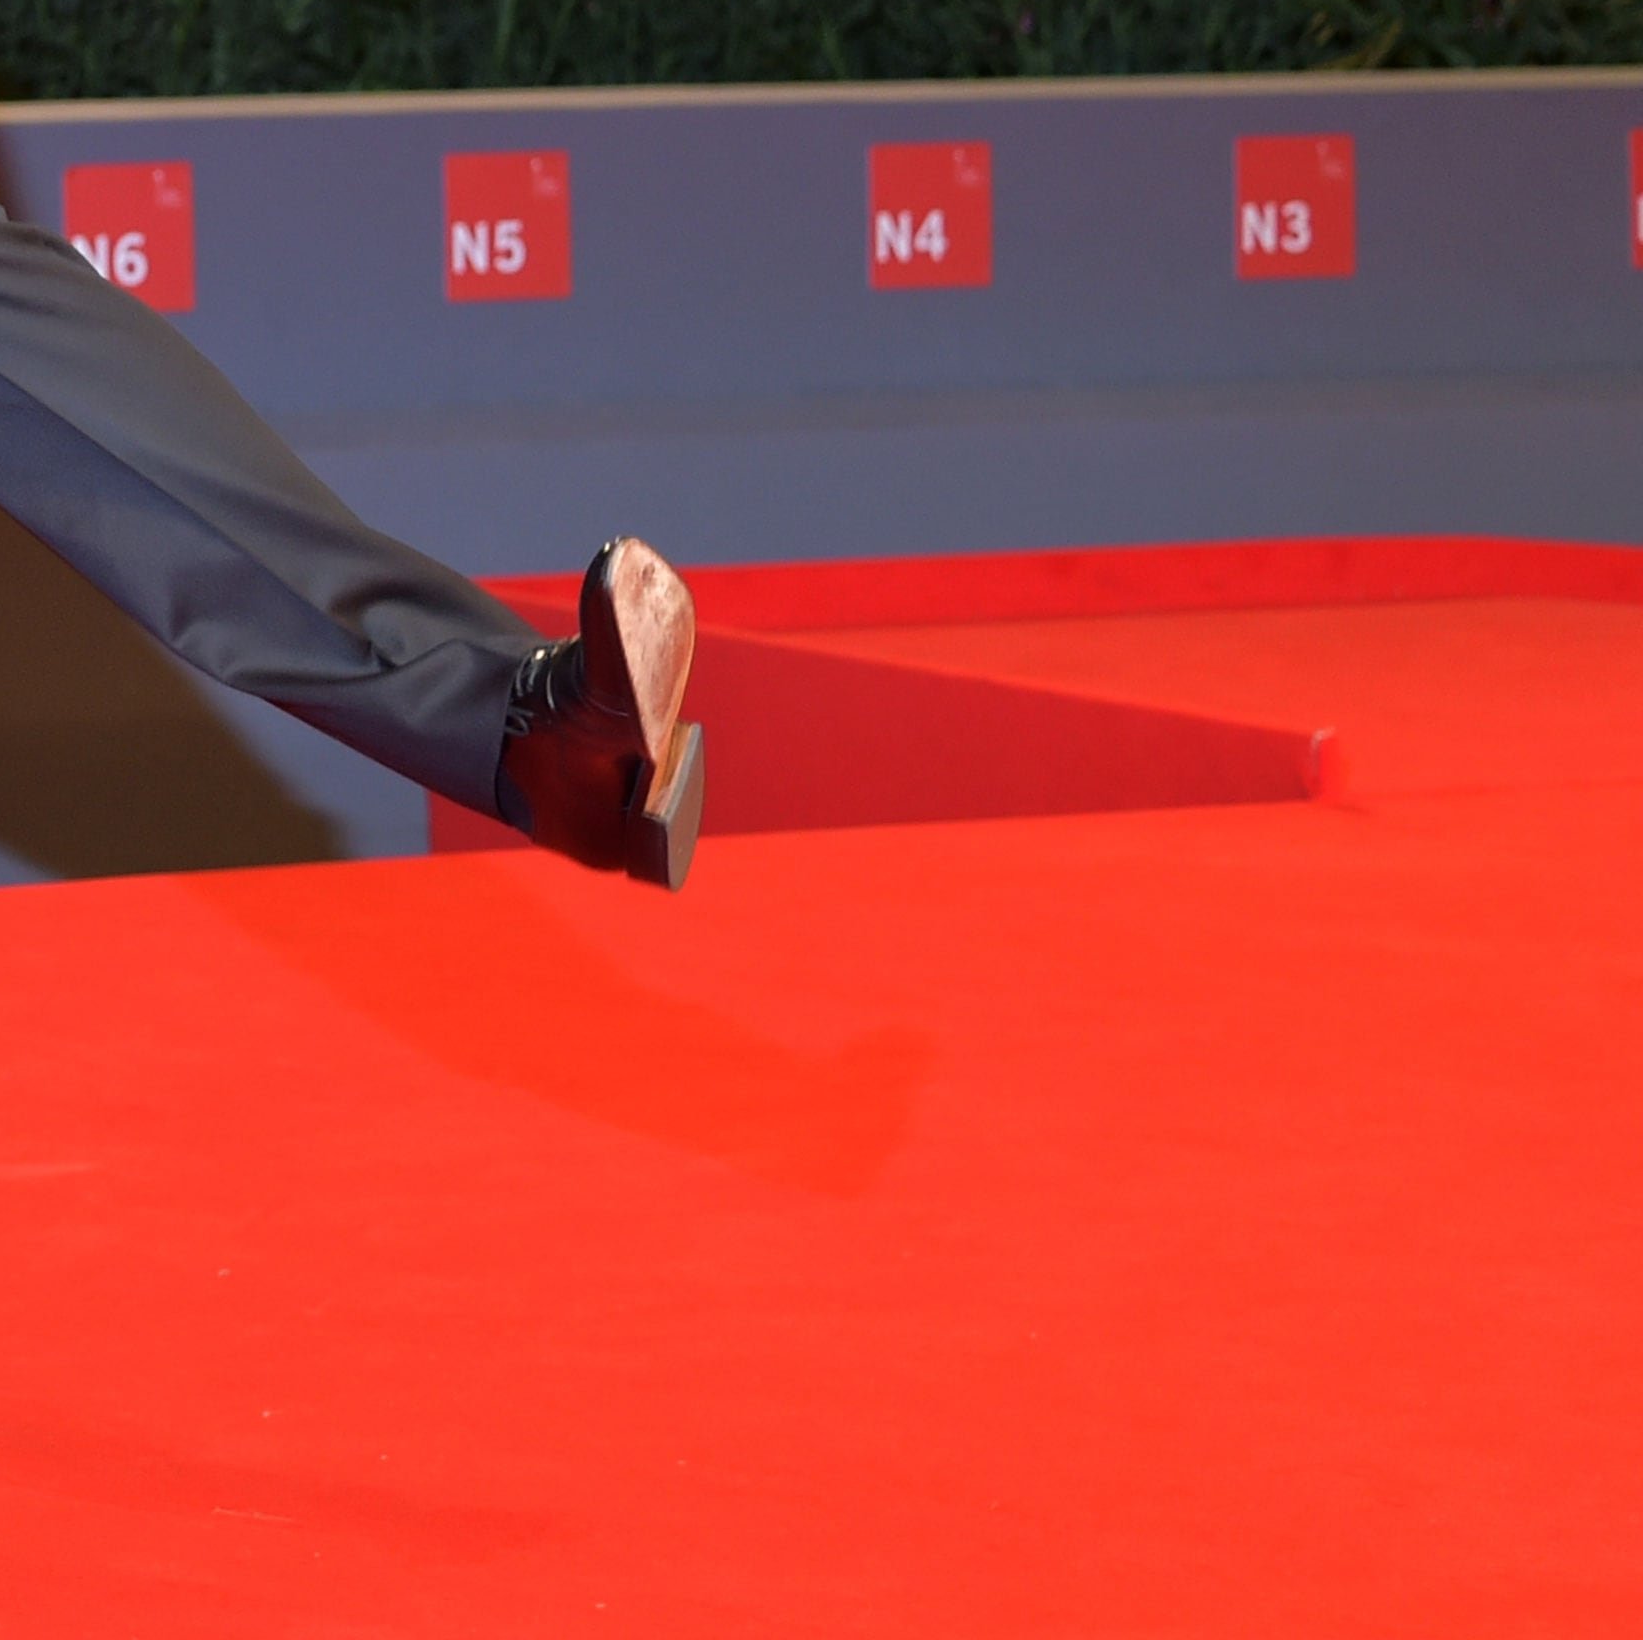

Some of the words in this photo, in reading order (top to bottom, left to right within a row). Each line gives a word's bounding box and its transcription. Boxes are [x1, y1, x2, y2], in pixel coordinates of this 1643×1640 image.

[451, 219, 526, 274] N5
[875, 210, 947, 262] N4
[1241, 201, 1312, 253] N3
[70, 232, 149, 287] N6
